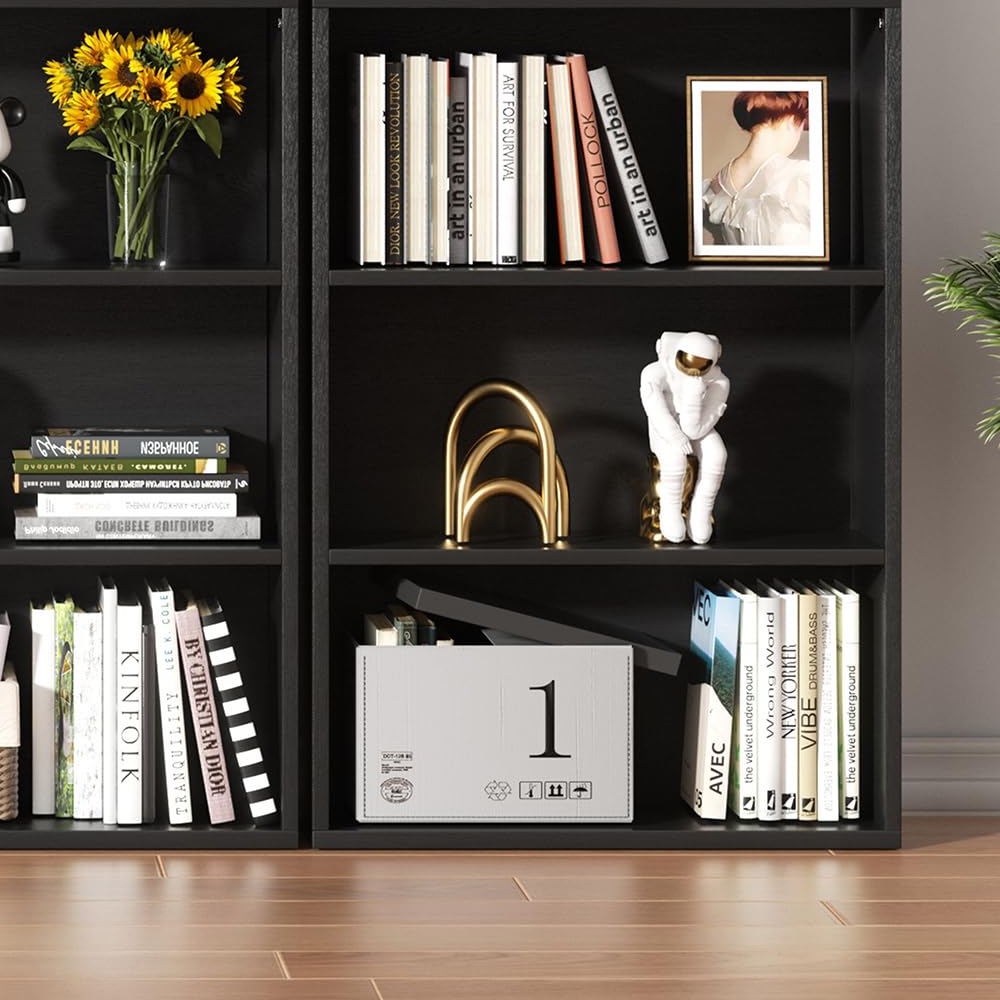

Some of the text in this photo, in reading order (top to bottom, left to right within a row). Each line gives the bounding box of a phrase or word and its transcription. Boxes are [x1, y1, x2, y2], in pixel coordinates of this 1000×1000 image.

[448, 101, 465, 241] art in an urban
[580, 112, 610, 209] POLLOCK
[121, 650, 140, 784] KINFOLK
[159, 593, 189, 816] TRANQUILITY LEE K. COLE
[183, 637, 227, 797] BY CHRISTIAN DIOR
[528, 679, 572, 758] 1
[744, 665, 755, 784] the velvet underground
[765, 612, 777, 739] Wrong World
[800, 612, 818, 751] VIBE DRUM&BASS
[708, 742, 726, 796] AVEC
